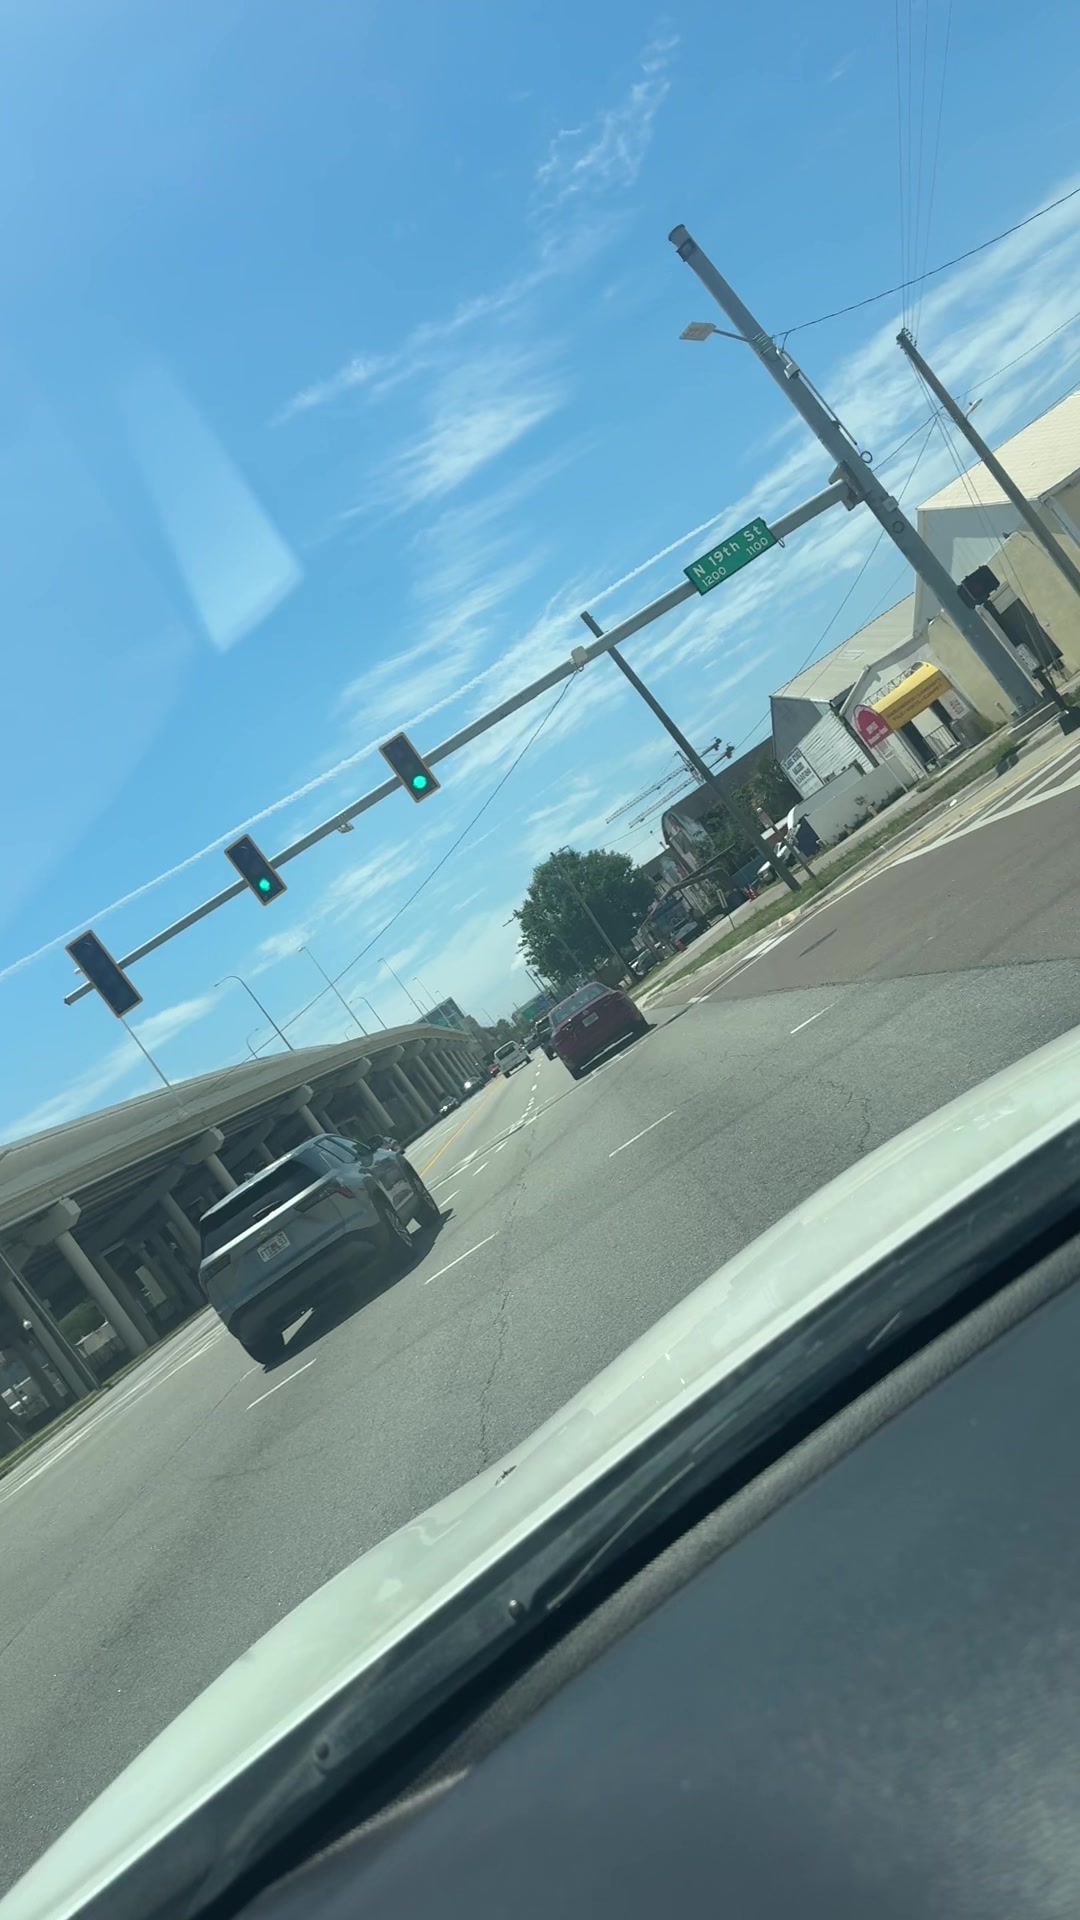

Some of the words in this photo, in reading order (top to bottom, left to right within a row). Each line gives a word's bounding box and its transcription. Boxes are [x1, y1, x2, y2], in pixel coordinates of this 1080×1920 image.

[692, 564, 706, 578] N
[708, 542, 740, 566] 19th
[743, 525, 762, 541] St
[702, 566, 726, 587] 1200
[746, 537, 768, 555] 1100
